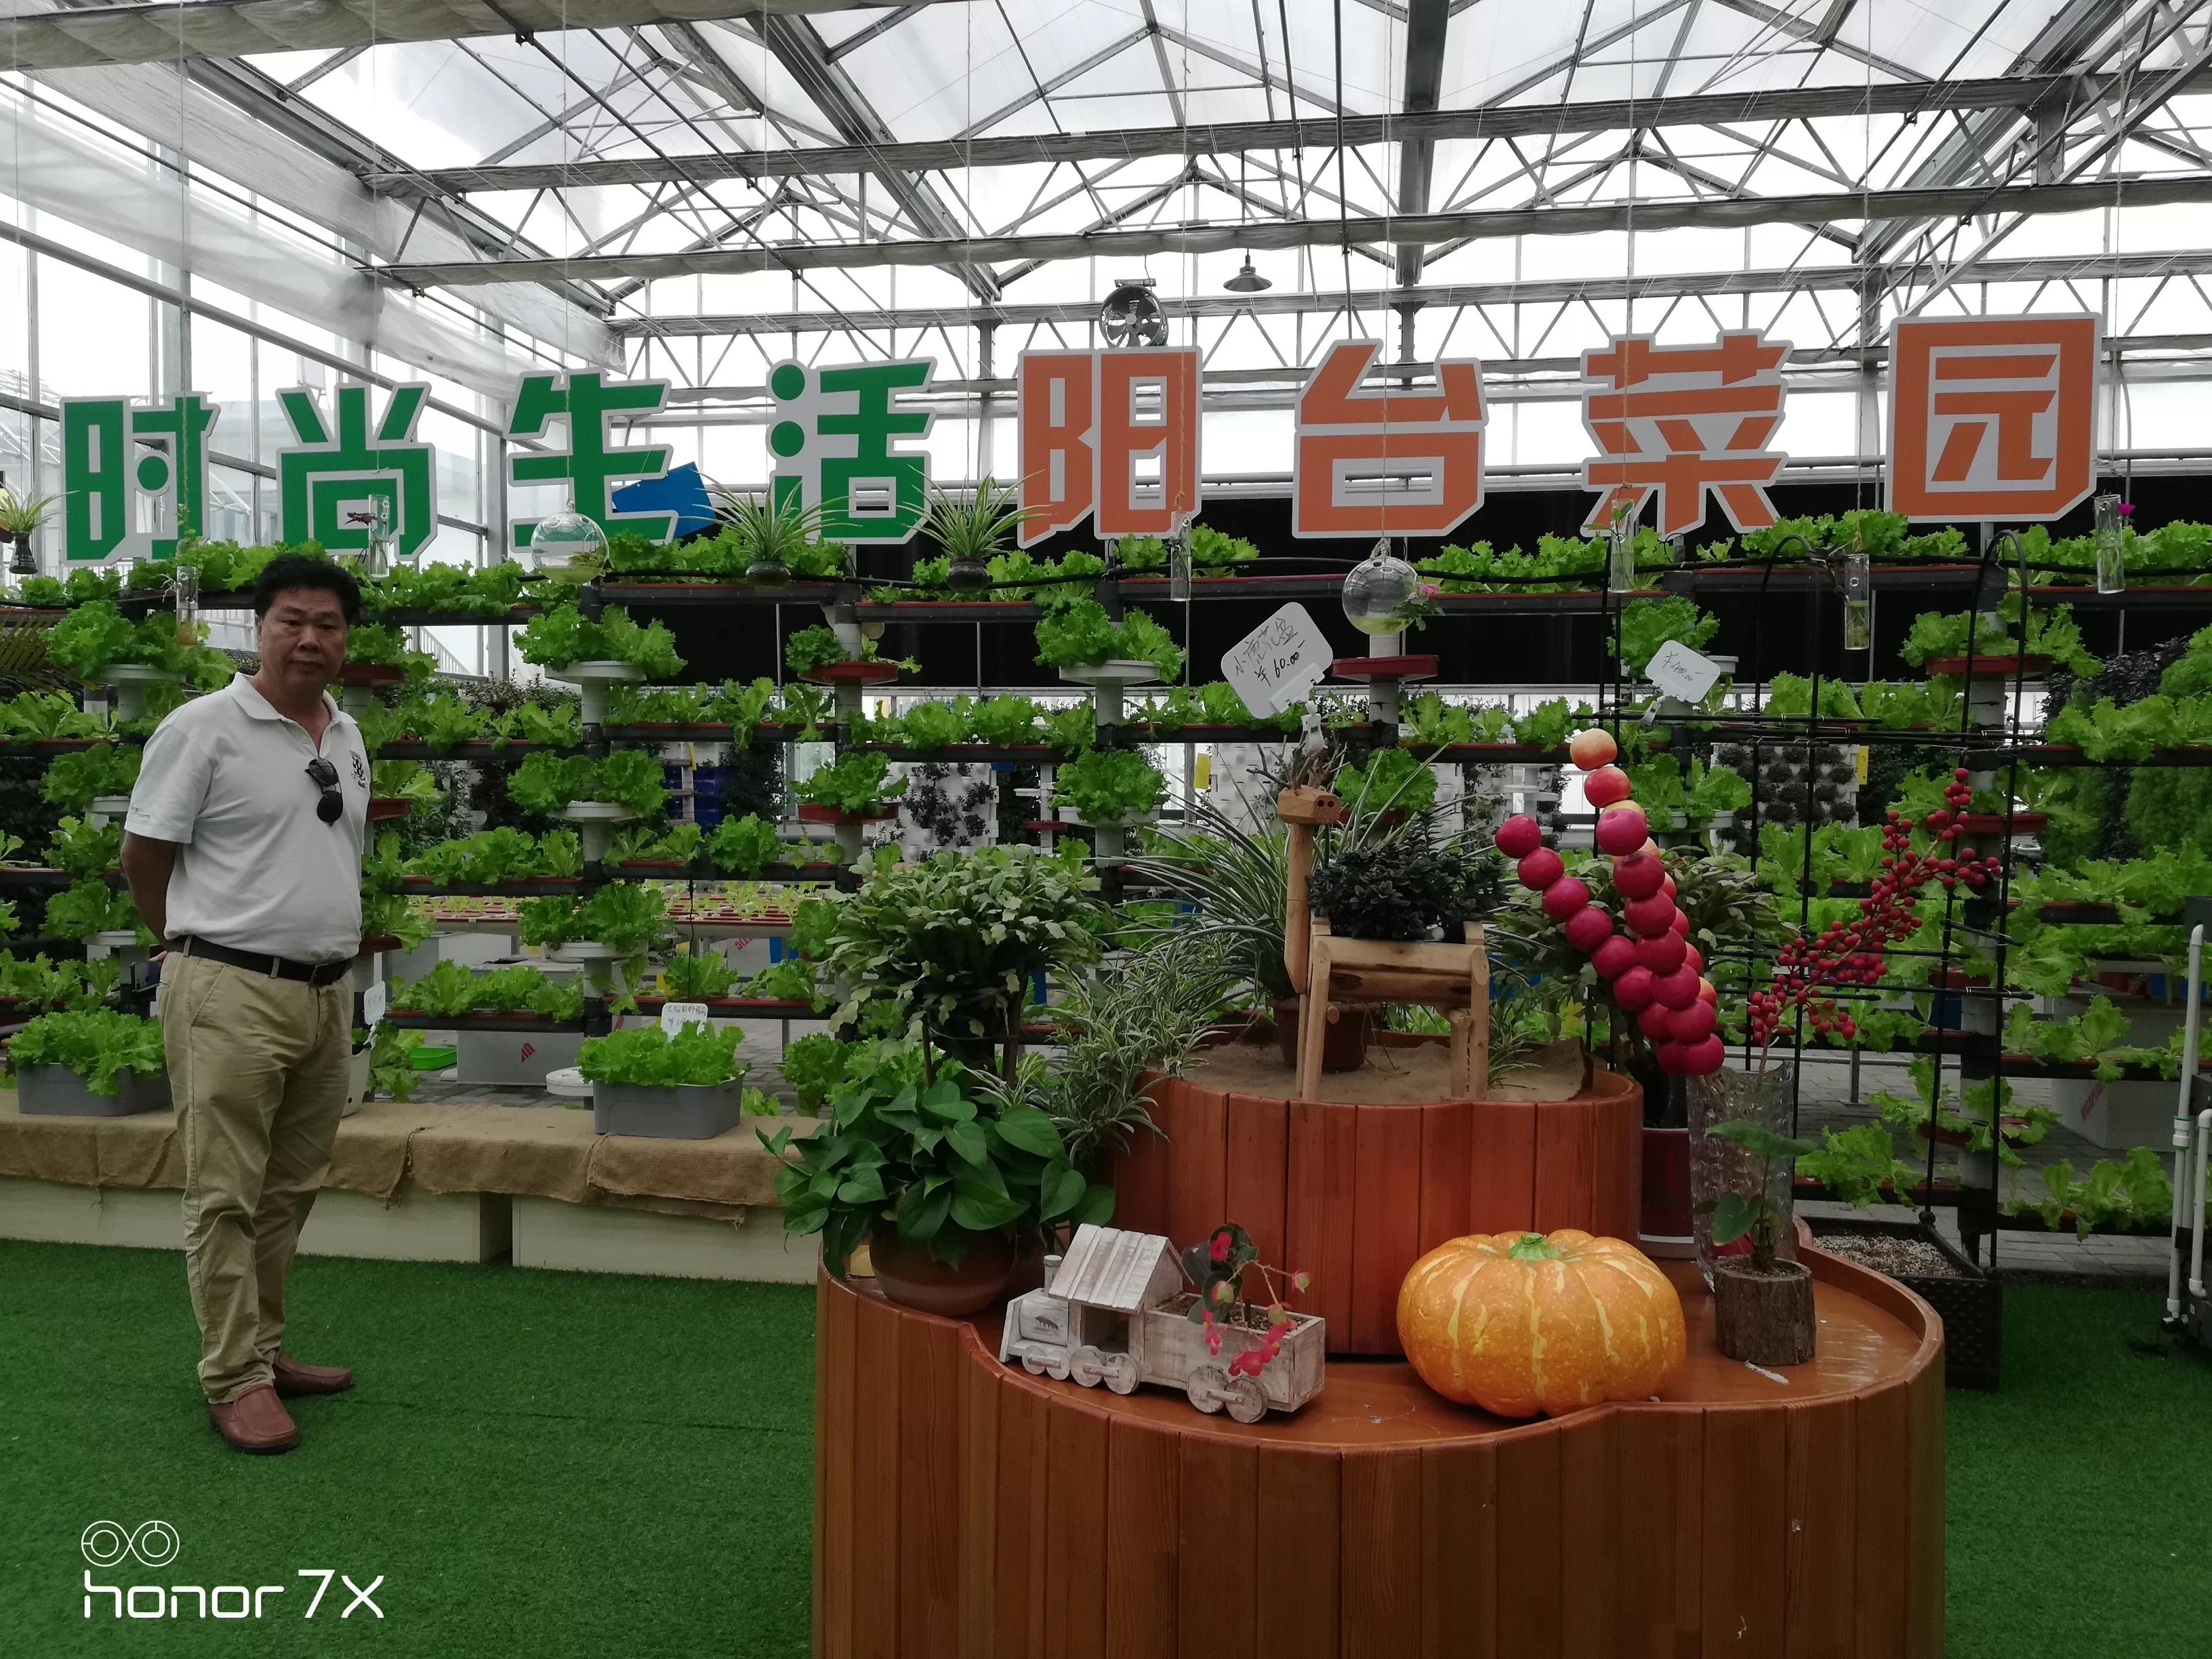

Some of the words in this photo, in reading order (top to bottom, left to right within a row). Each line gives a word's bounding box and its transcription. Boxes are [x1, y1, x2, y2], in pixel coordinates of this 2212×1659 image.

[60, 356, 937, 567] 时尚生活
[1018, 312, 2102, 549] 阳台菜园
